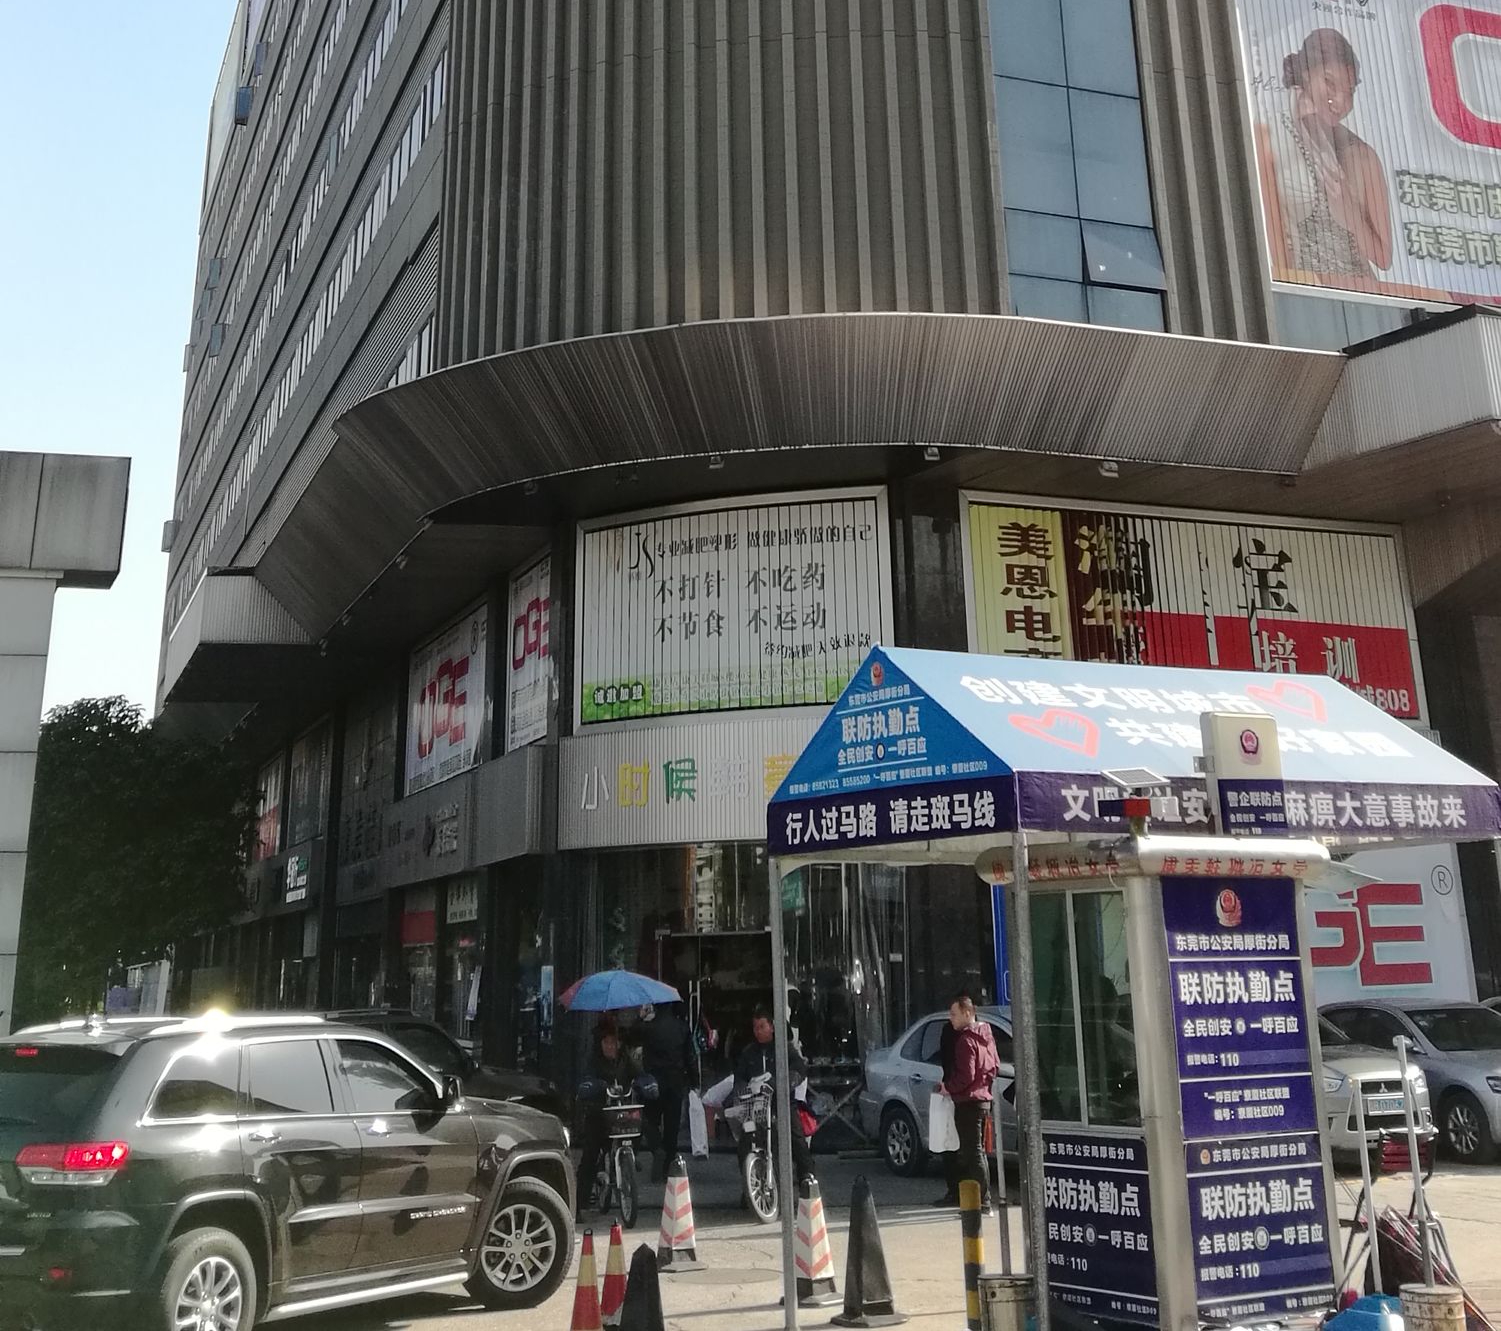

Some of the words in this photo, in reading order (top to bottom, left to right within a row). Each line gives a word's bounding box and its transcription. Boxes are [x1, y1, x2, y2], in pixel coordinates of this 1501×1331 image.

[1404, 222, 1501, 268] 东莞市
[654, 569, 725, 604] 不打针
[744, 562, 826, 595] 不吃药
[654, 609, 725, 643] 不节食
[744, 602, 826, 634] 不运动
[841, 706, 920, 745] 联防执勤点
[837, 745, 874, 766] 全民创安
[888, 736, 927, 757] 一呼百应
[786, 802, 877, 846] 行人过马路
[889, 788, 996, 834] 请走斑马线
[1284, 791, 1467, 829] 麻痹大意事故来
[1176, 933, 1291, 952] 东莞市公安局厚街分局
[1178, 970, 1296, 1005] 联防执勤点
[1183, 1018, 1233, 1038] 全民创安
[1250, 1015, 1299, 1035] 一呼百应
[1212, 1143, 1307, 1163] 东莞市公安局厚街分局
[1200, 1177, 1315, 1221] 联防执勤点
[1098, 1230, 1149, 1252] 一呼百应
[1199, 1230, 1255, 1255] 全民创安
[1270, 1224, 1324, 1246] 一呼百应
